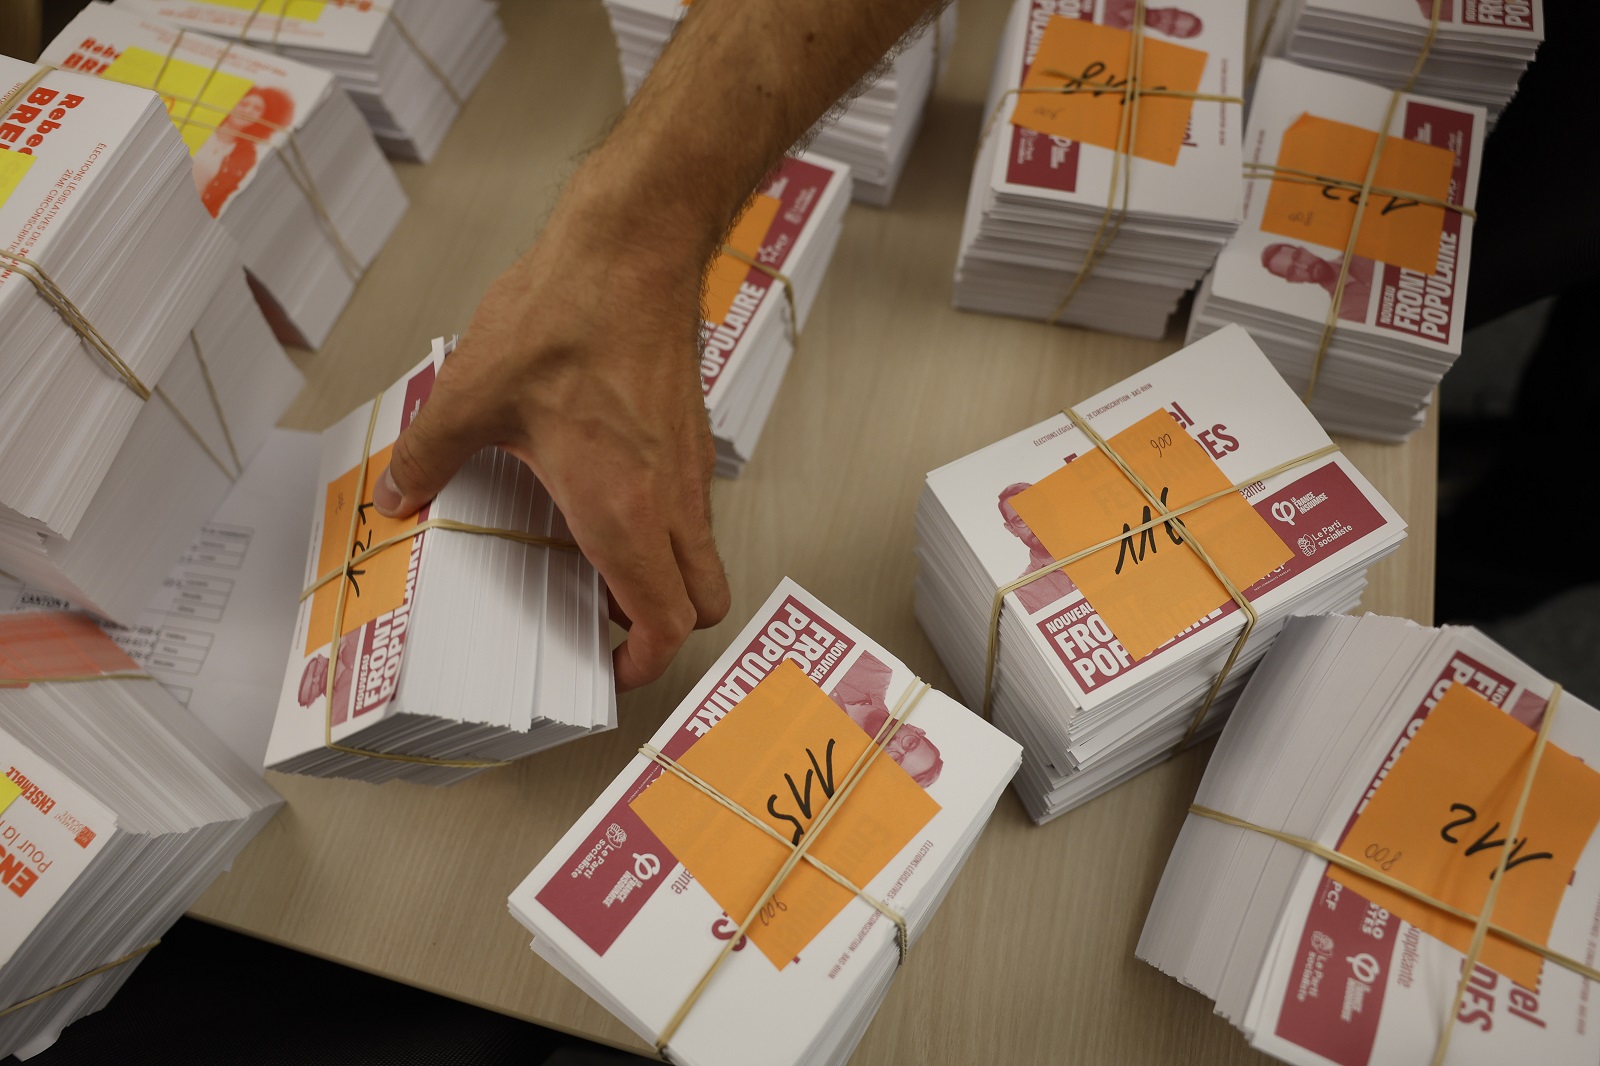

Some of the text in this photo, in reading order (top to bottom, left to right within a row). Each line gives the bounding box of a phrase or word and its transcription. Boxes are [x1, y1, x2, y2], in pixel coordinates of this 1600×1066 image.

[74, 142, 107, 182] ÉLECTIONS
[37, 181, 76, 232] LÉGISLATIVES
[1033, 431, 1059, 447] ÉLECTIONS
[1092, 393, 1131, 419] CIRCONSCRIPTION
[1130, 382, 1153, 399] BAS-RHIN
[1294, 491, 1317, 510] FRANCE
[1298, 492, 1329, 515] INSOUMISE
[1114, 486, 1185, 576] 116
[1311, 519, 1343, 541] Le Parti
[1317, 524, 1353, 549] socialiste
[685, 602, 811, 738] POPULAIRE
[2, 825, 53, 874] Pour la
[571, 838, 606, 879] socialiste
[583, 845, 615, 879] Le Parti
[912, 839, 934, 868] ÉLECTIONS
[601, 869, 632, 908] INSOUMISE
[617, 875, 640, 903] FRANCE
[886, 866, 915, 900] LÉGISLATIVES
[1325, 880, 1344, 912] PCF
[828, 951, 851, 980] BAS-RHIN
[1296, 951, 1317, 1004] socialiste
[1307, 969, 1325, 998] Parti
